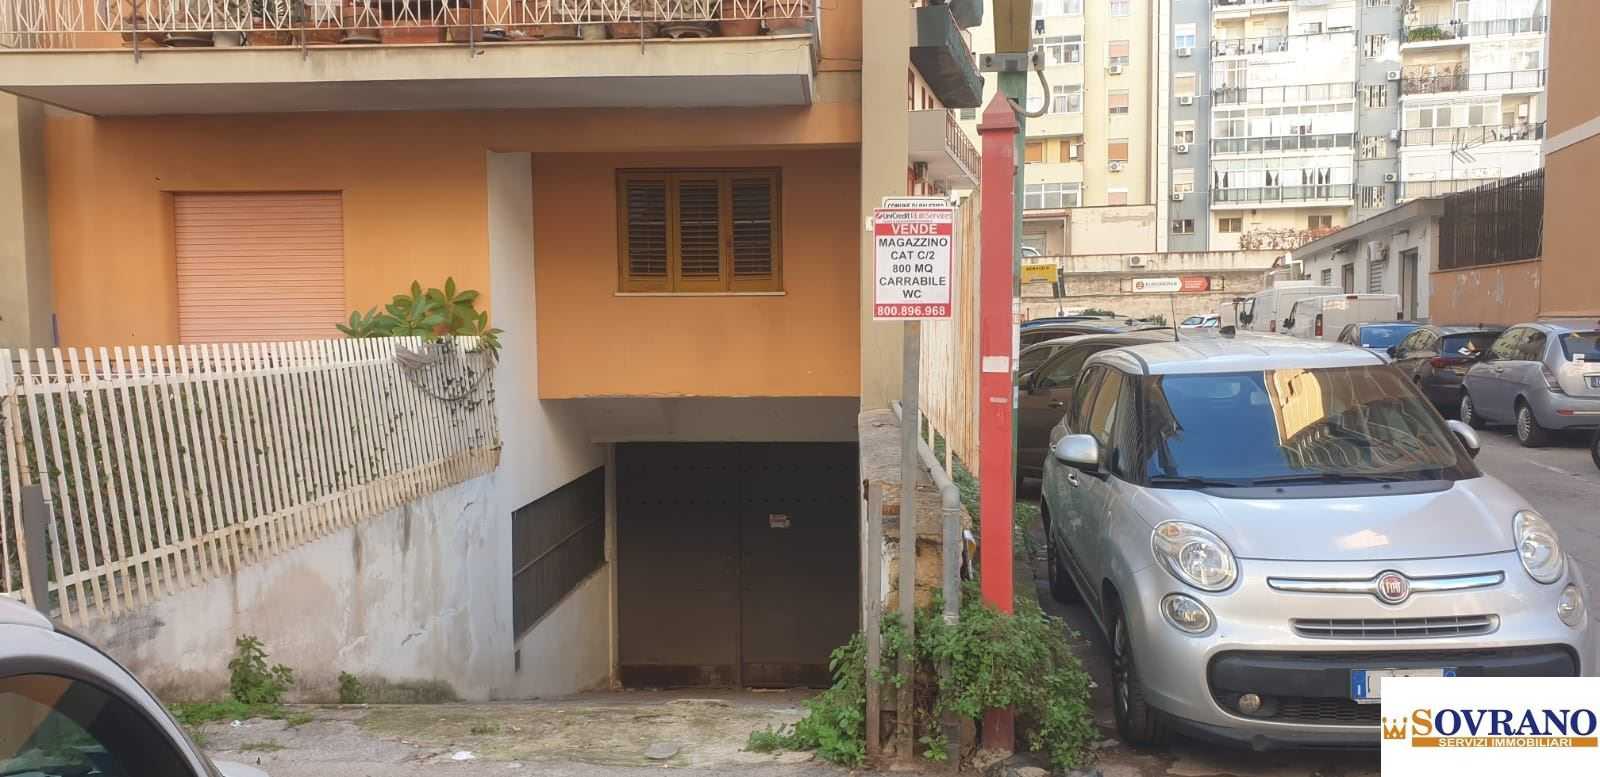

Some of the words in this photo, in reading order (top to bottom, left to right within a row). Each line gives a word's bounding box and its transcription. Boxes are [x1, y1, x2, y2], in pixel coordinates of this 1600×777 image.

[891, 223, 938, 235] VENDE
[879, 238, 948, 247] MAGAZZINO
[890, 250, 914, 260] CAT
[917, 250, 935, 260] C/2
[892, 263, 911, 273] 800
[914, 263, 933, 273] MQ
[879, 276, 946, 286] CARRABILE
[902, 289, 922, 298] WC
[877, 305, 945, 316] 800.896.968
